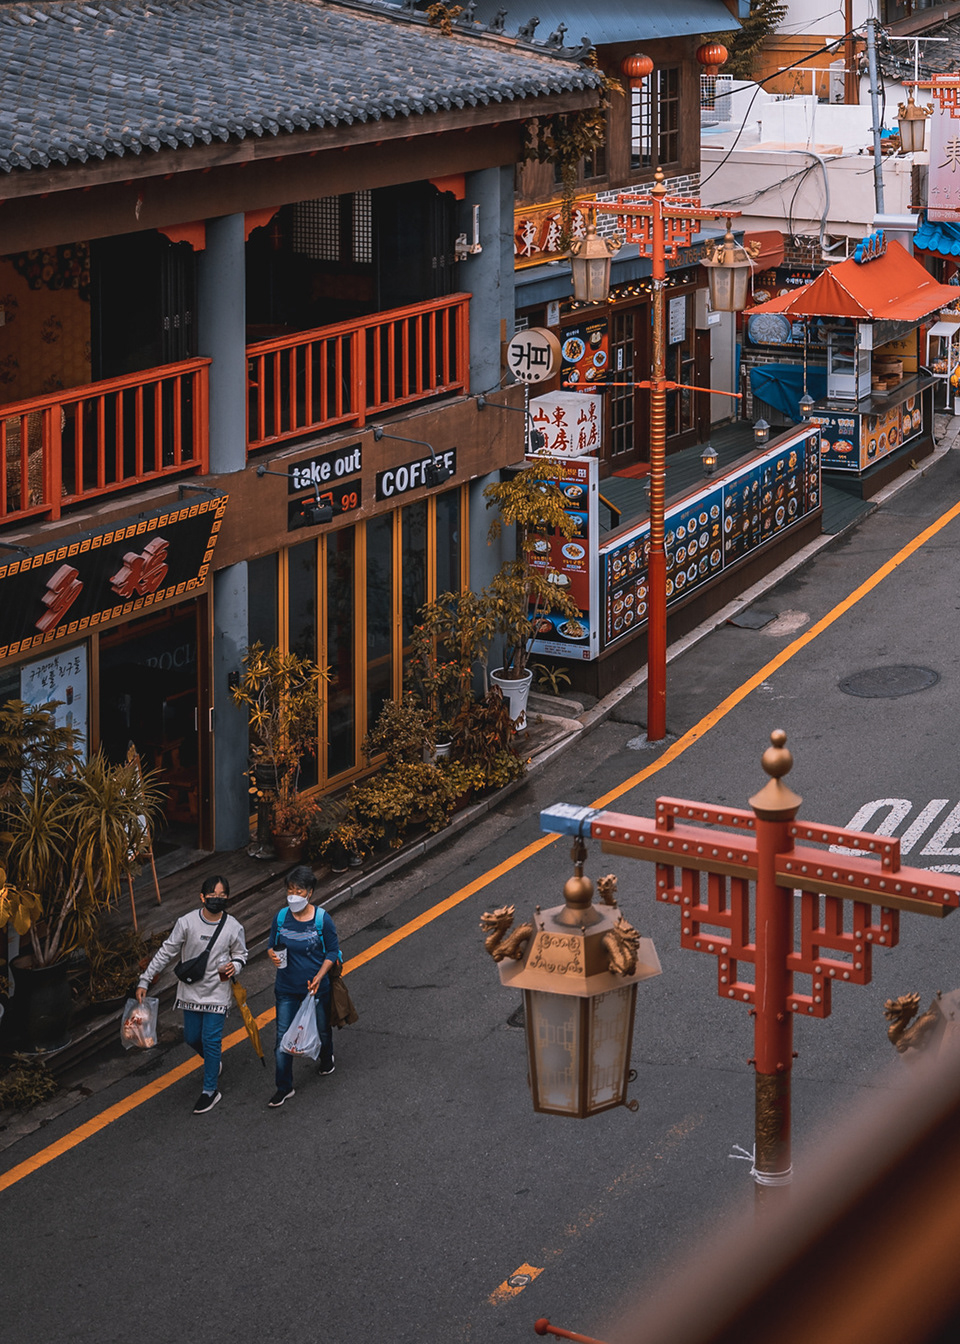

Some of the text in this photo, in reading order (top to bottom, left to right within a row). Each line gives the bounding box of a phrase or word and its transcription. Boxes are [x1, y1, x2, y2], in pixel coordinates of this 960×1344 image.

[511, 342, 550, 370] 커피
[533, 405, 568, 428] 山東
[576, 401, 598, 426] 山東
[292, 448, 362, 490] take out
[381, 451, 454, 497] COFFE
[341, 492, 358, 511] 99
